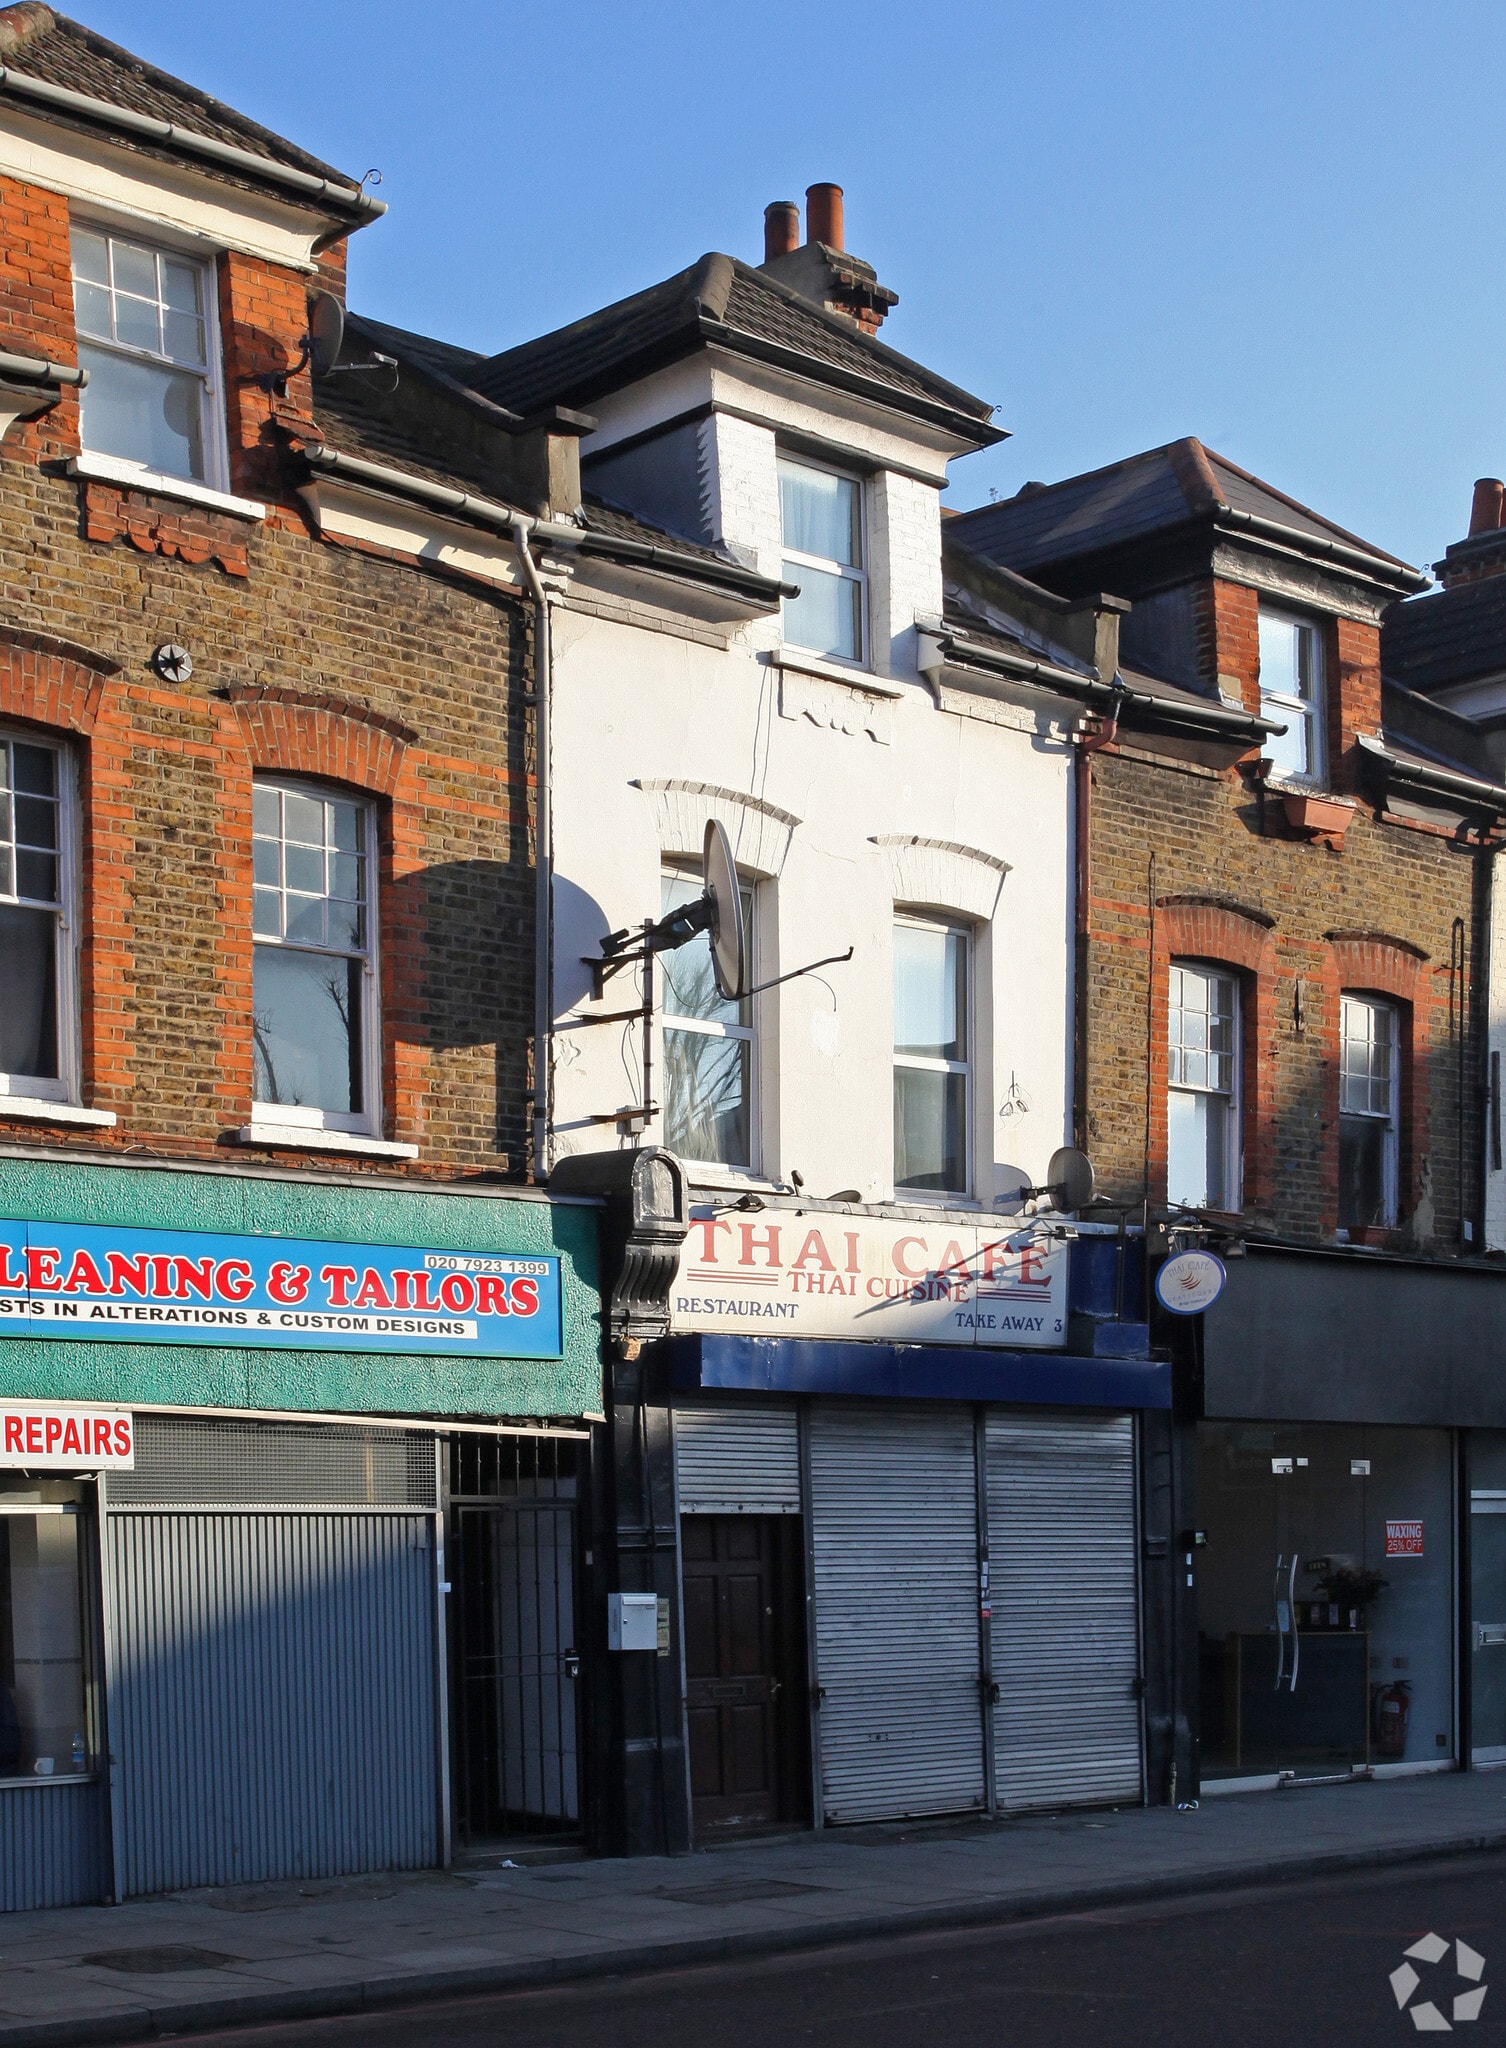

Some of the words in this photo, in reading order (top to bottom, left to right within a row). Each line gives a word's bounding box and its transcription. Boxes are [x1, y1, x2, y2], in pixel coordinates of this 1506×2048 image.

[689, 1217, 862, 1273] THAI
[891, 1236, 1052, 1288] CAFE
[427, 1256, 458, 1270] 020
[463, 1258, 502, 1273] 7923
[508, 1261, 547, 1275] 1399
[1167, 1263, 1186, 1278] THAI
[266, 1261, 311, 1304] &
[322, 1266, 539, 1316] TAILORS
[786, 1270, 857, 1296] THAI
[866, 1277, 971, 1303] CUISINE
[54, 1303, 78, 1317] IN
[90, 1305, 248, 1325] ALTERATIONS
[257, 1312, 272, 1325] &
[279, 1313, 369, 1331] CUSTOM
[376, 1319, 466, 1335] DESIGNS
[676, 1297, 799, 1319] RESTAURANT
[955, 1312, 997, 1329] TAKE
[1002, 1315, 1045, 1332] AWAY
[1054, 1319, 1063, 1333] 3
[4, 1415, 132, 1457] REPAIRS
[1386, 1525, 1422, 1539] WAXING
[1387, 1539, 1405, 1551] 25%
[1406, 1539, 1423, 1551] OFF
